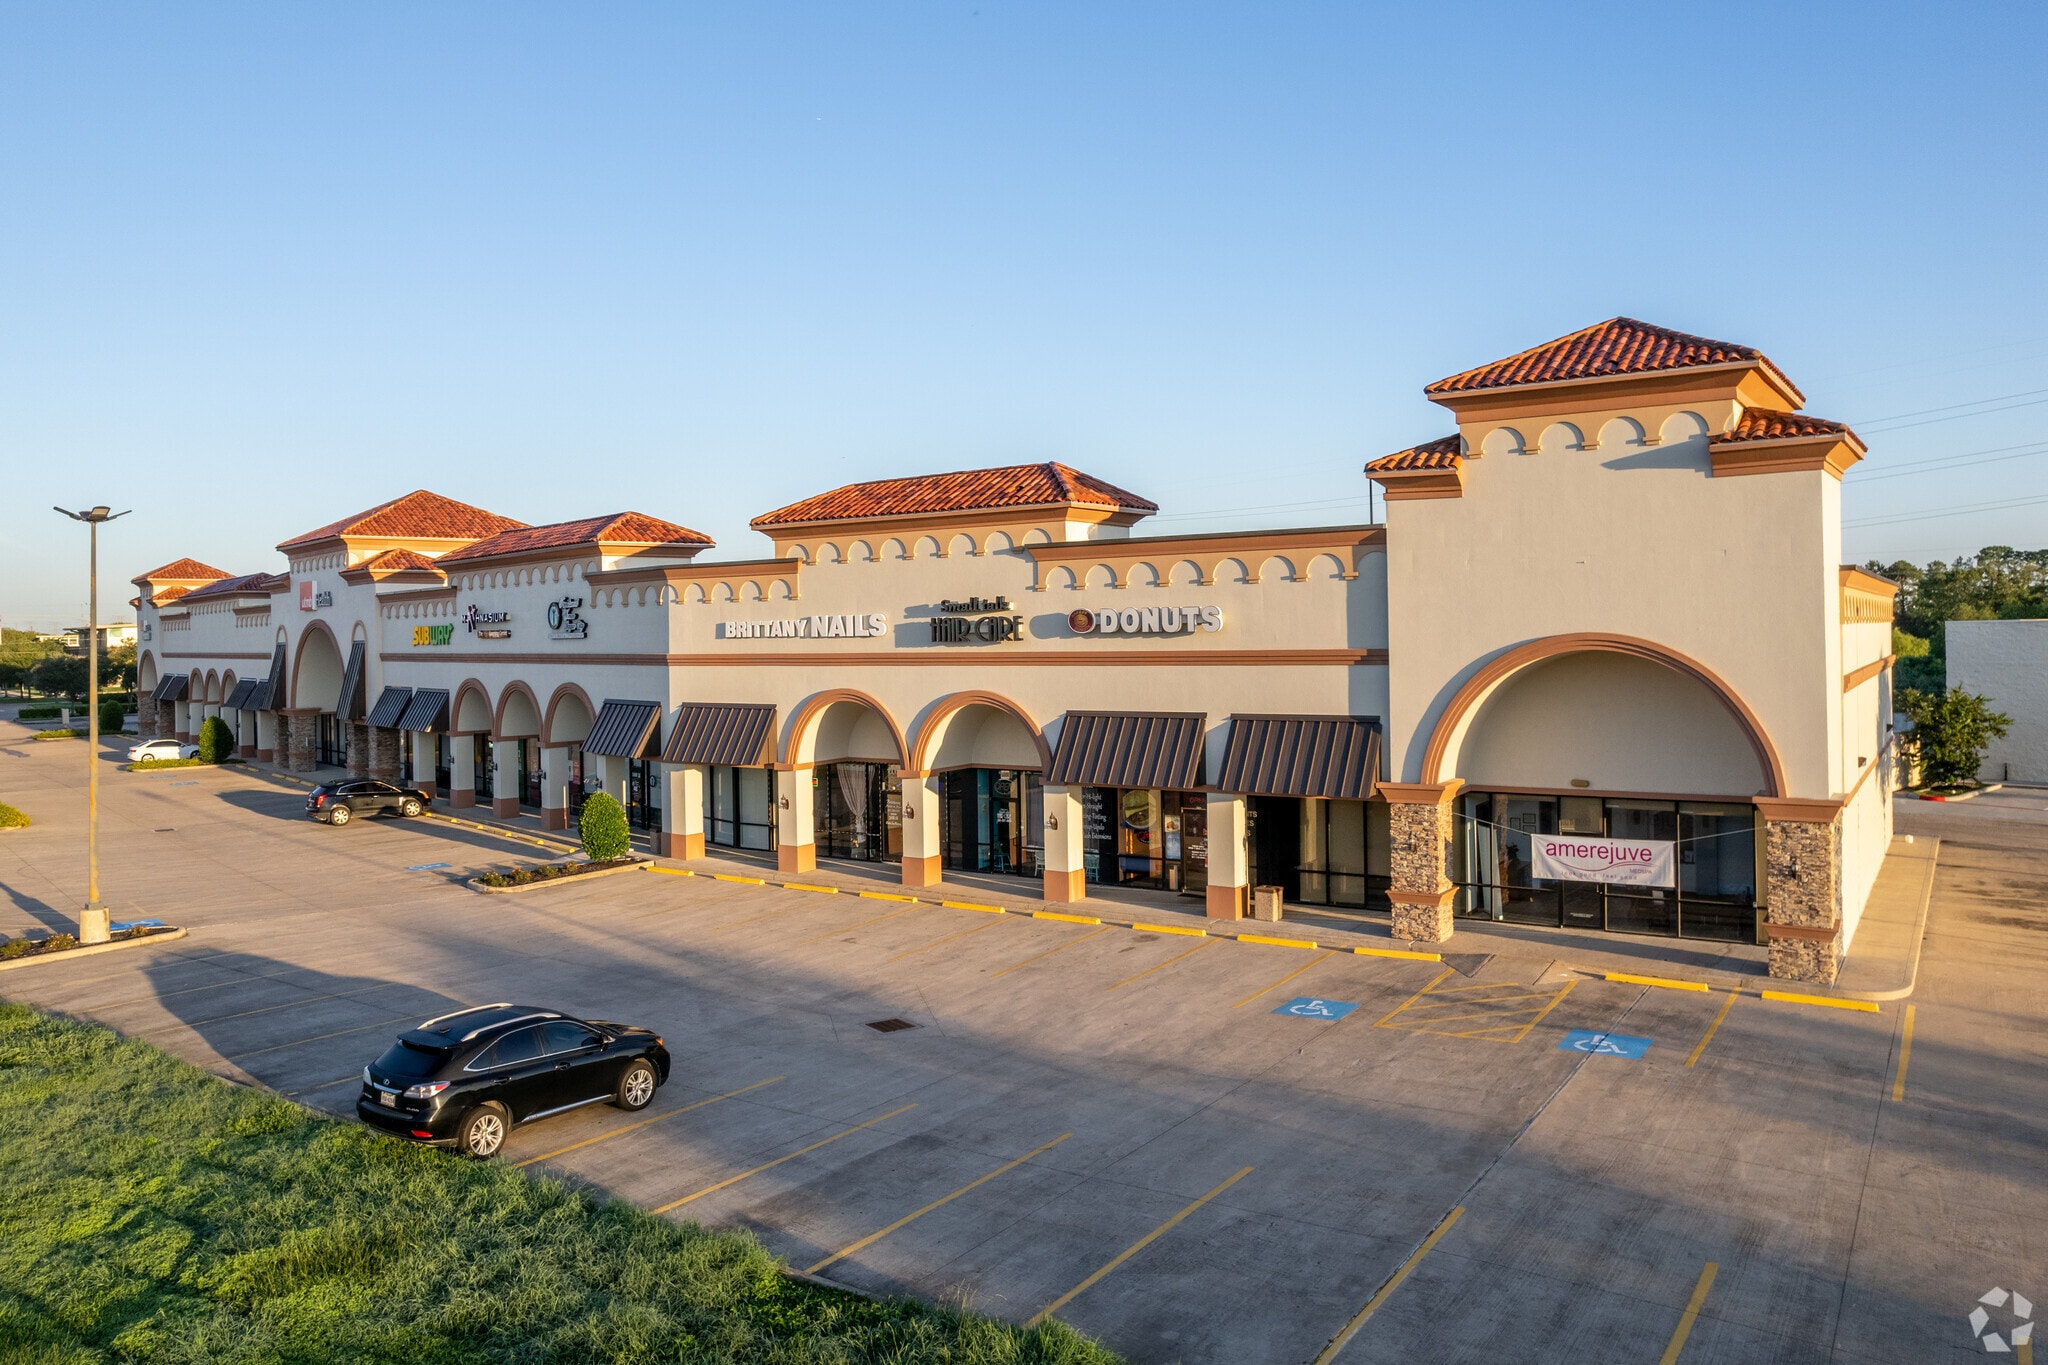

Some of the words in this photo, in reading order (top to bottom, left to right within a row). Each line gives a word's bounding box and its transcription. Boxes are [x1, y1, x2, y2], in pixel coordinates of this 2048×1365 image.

[940, 596, 980, 612] Small
[982, 596, 1010, 611] talk
[461, 604, 508, 642] MATHNASIUM
[725, 619, 808, 638] BRITTANY
[811, 613, 887, 638] NAILS
[930, 617, 971, 642] HAIR
[974, 615, 1024, 641] CARE
[1100, 605, 1223, 633] DONUTS
[411, 623, 454, 647] SUBWAY
[1545, 842, 1653, 865] amerejuve
